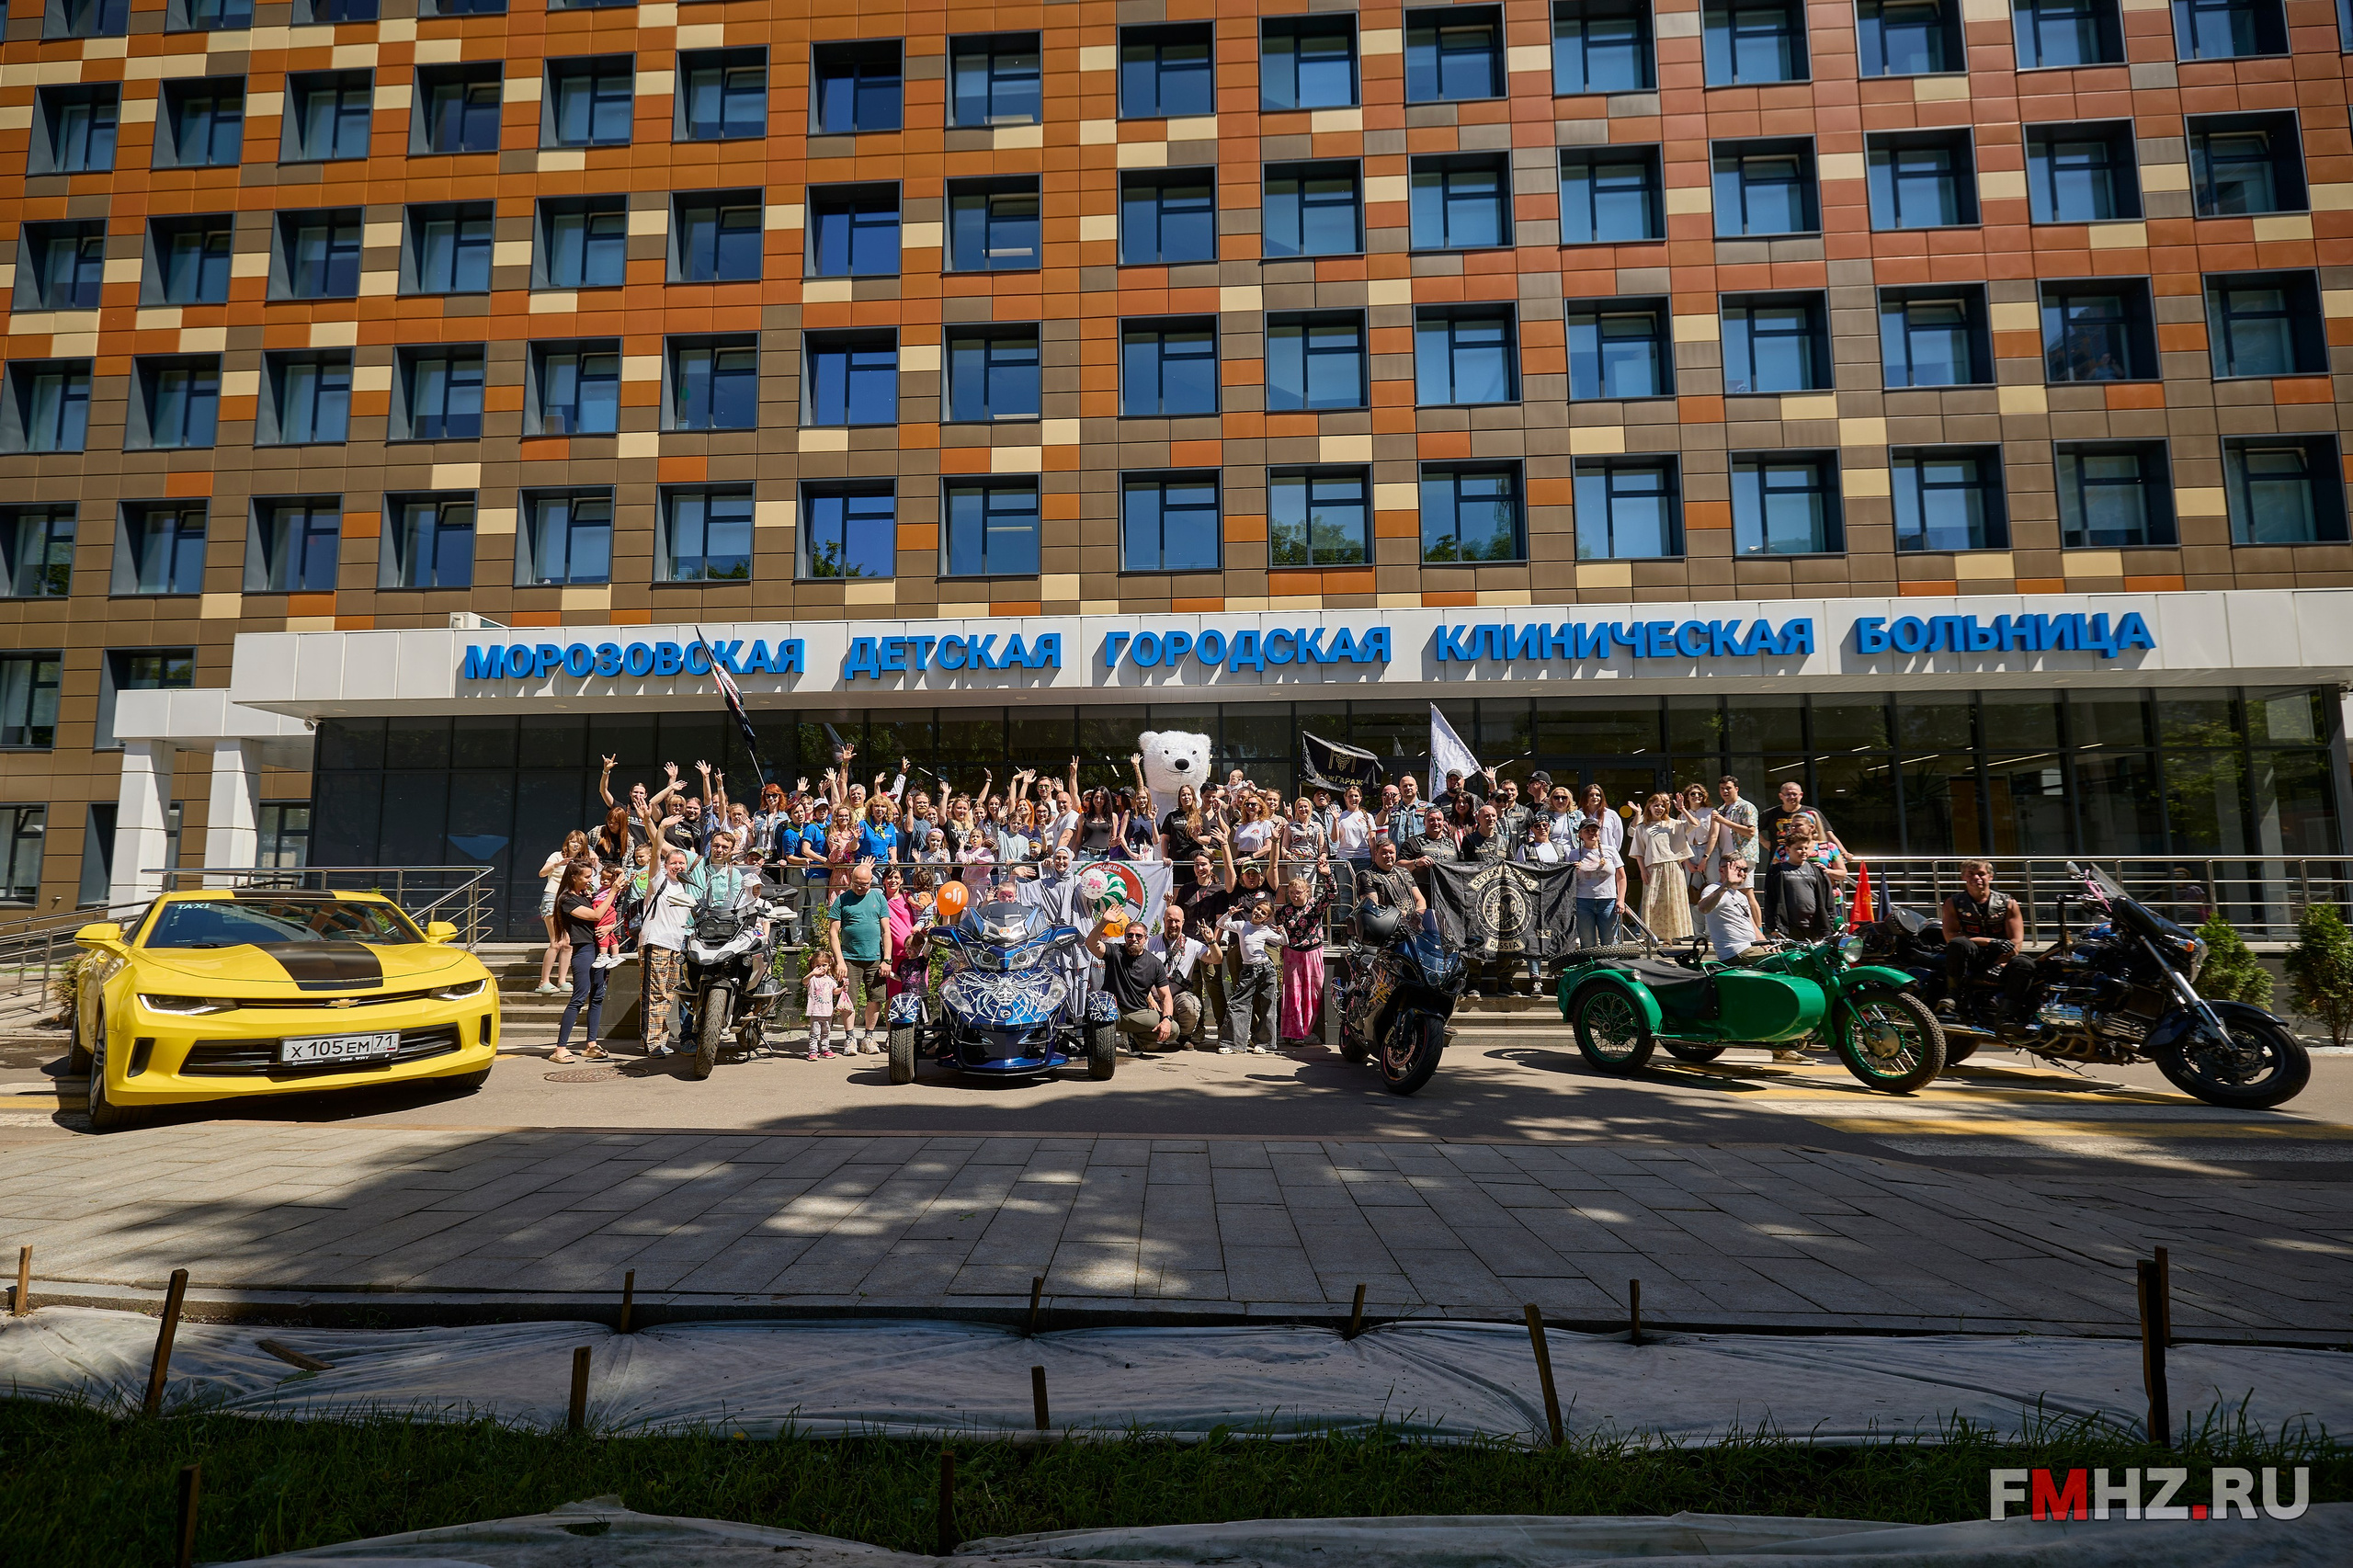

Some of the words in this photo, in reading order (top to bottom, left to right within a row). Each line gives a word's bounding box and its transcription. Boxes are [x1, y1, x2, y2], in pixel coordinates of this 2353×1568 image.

[464, 638, 806, 679] МОРОЗОВСКАЯ
[844, 632, 1062, 680] ДЕТСКАЯ
[1105, 626, 1392, 672] ГОРОДСКАЯ
[1437, 618, 1814, 661] КЛИНИЧЕСКАЯ
[1857, 612, 2156, 659] БОЛЬНИЦА
[1092, 864, 1121, 873] ОСКВА
[1472, 869, 1500, 888] SEVEN
[1504, 868, 1534, 888] ROADS
[1489, 940, 1520, 950] RUSSIA
